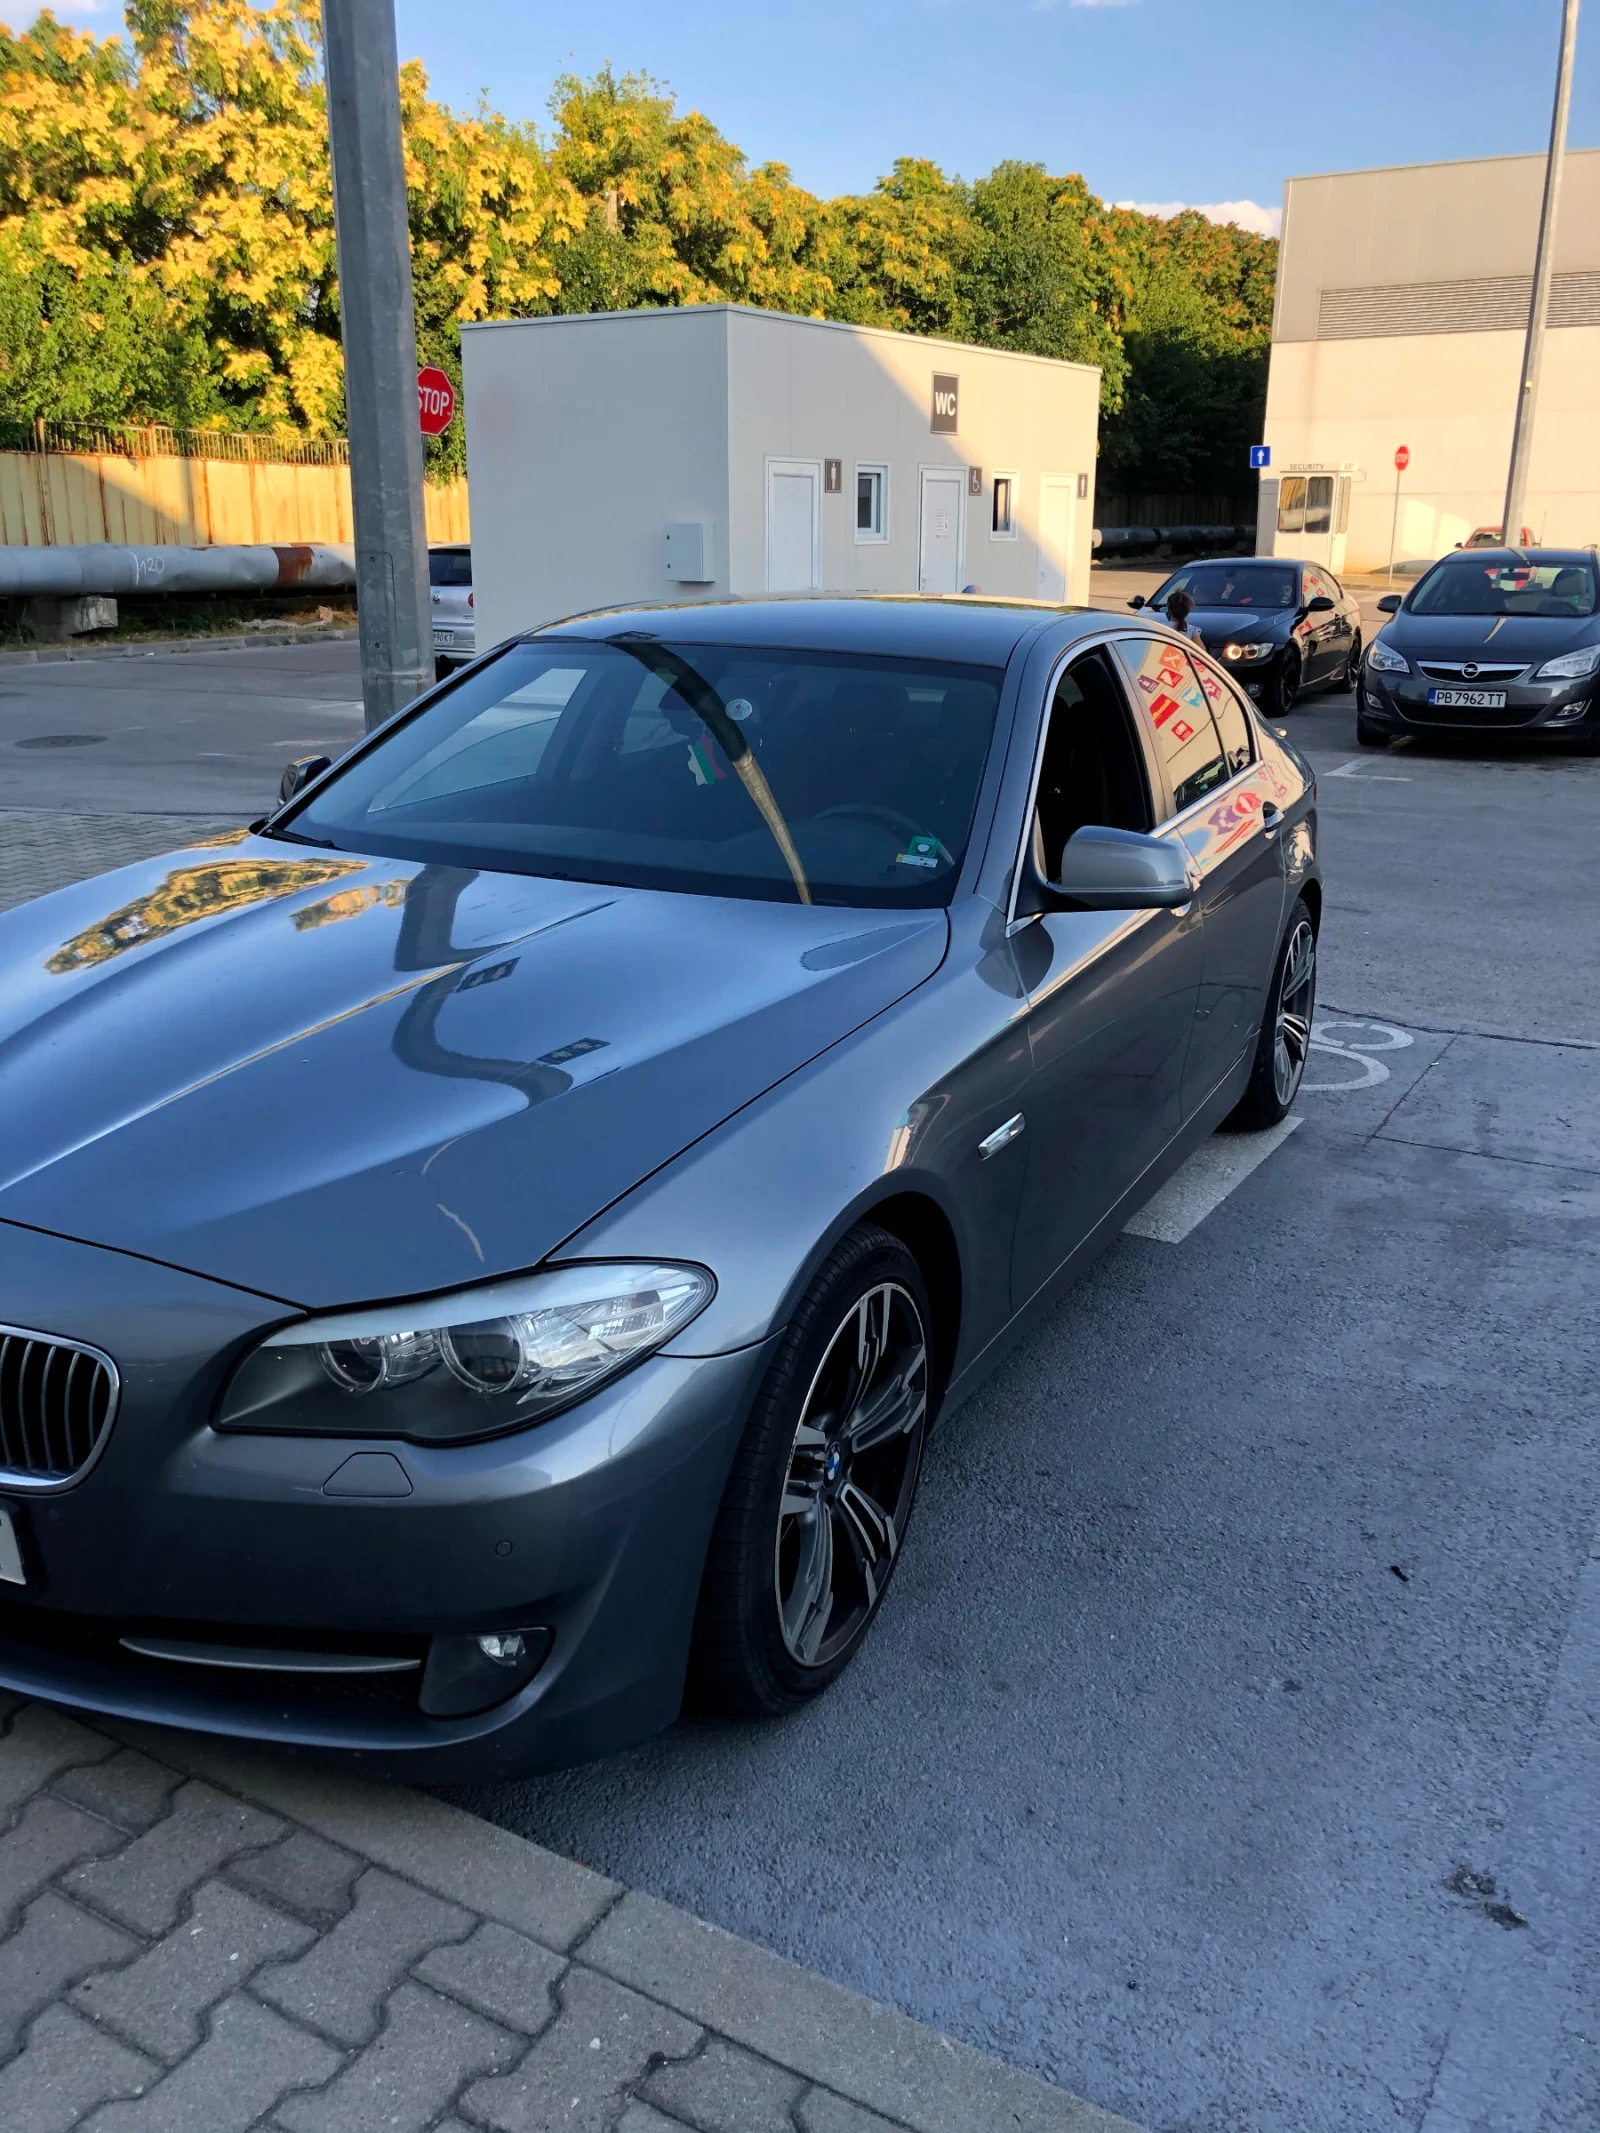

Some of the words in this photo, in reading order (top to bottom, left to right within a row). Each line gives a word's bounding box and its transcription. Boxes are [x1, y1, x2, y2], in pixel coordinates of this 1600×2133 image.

[935, 391, 957, 417] WC
[1289, 463, 1325, 471] SECURITY
[1436, 691, 1453, 704] PB
[1454, 692, 1485, 705] 7962
[1487, 693, 1504, 706] TT
